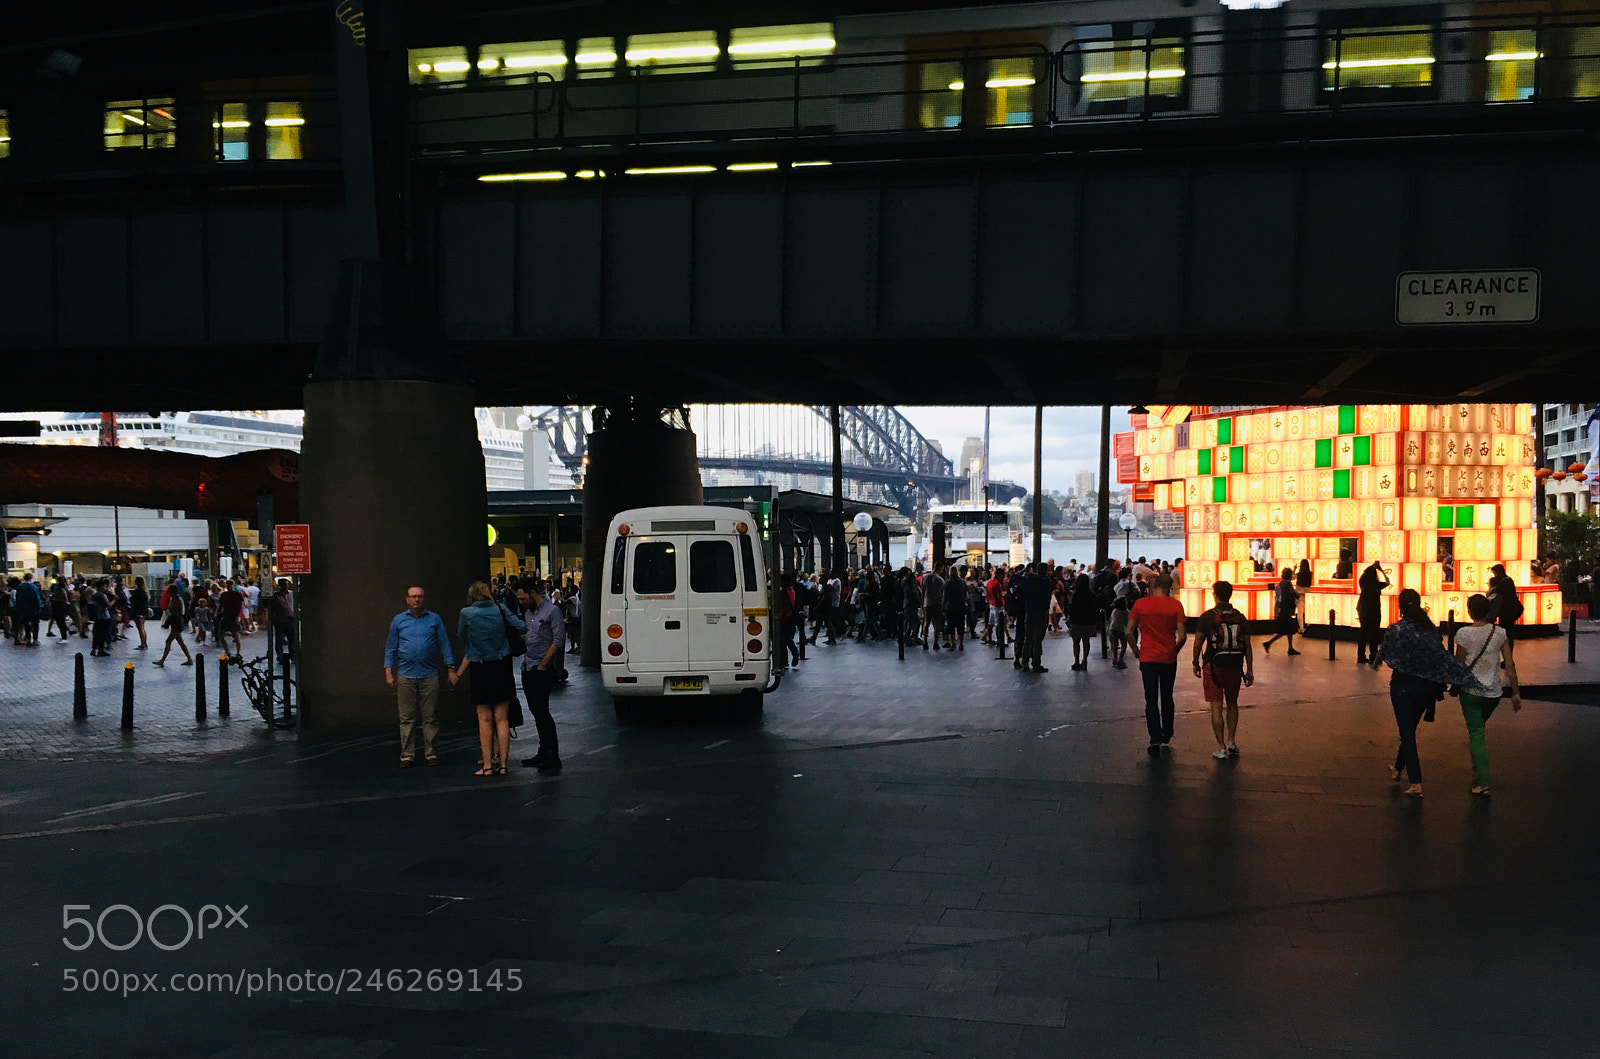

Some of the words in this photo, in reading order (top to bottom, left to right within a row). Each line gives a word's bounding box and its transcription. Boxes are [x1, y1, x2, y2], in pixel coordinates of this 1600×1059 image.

[1408, 276, 1529, 295] CLEARANCE
[1446, 438, 1457, 458] 東
[1463, 440, 1473, 458] 南
[1479, 441, 1489, 457] 西
[1495, 442, 1506, 457] 北
[1380, 474, 1391, 490] 西
